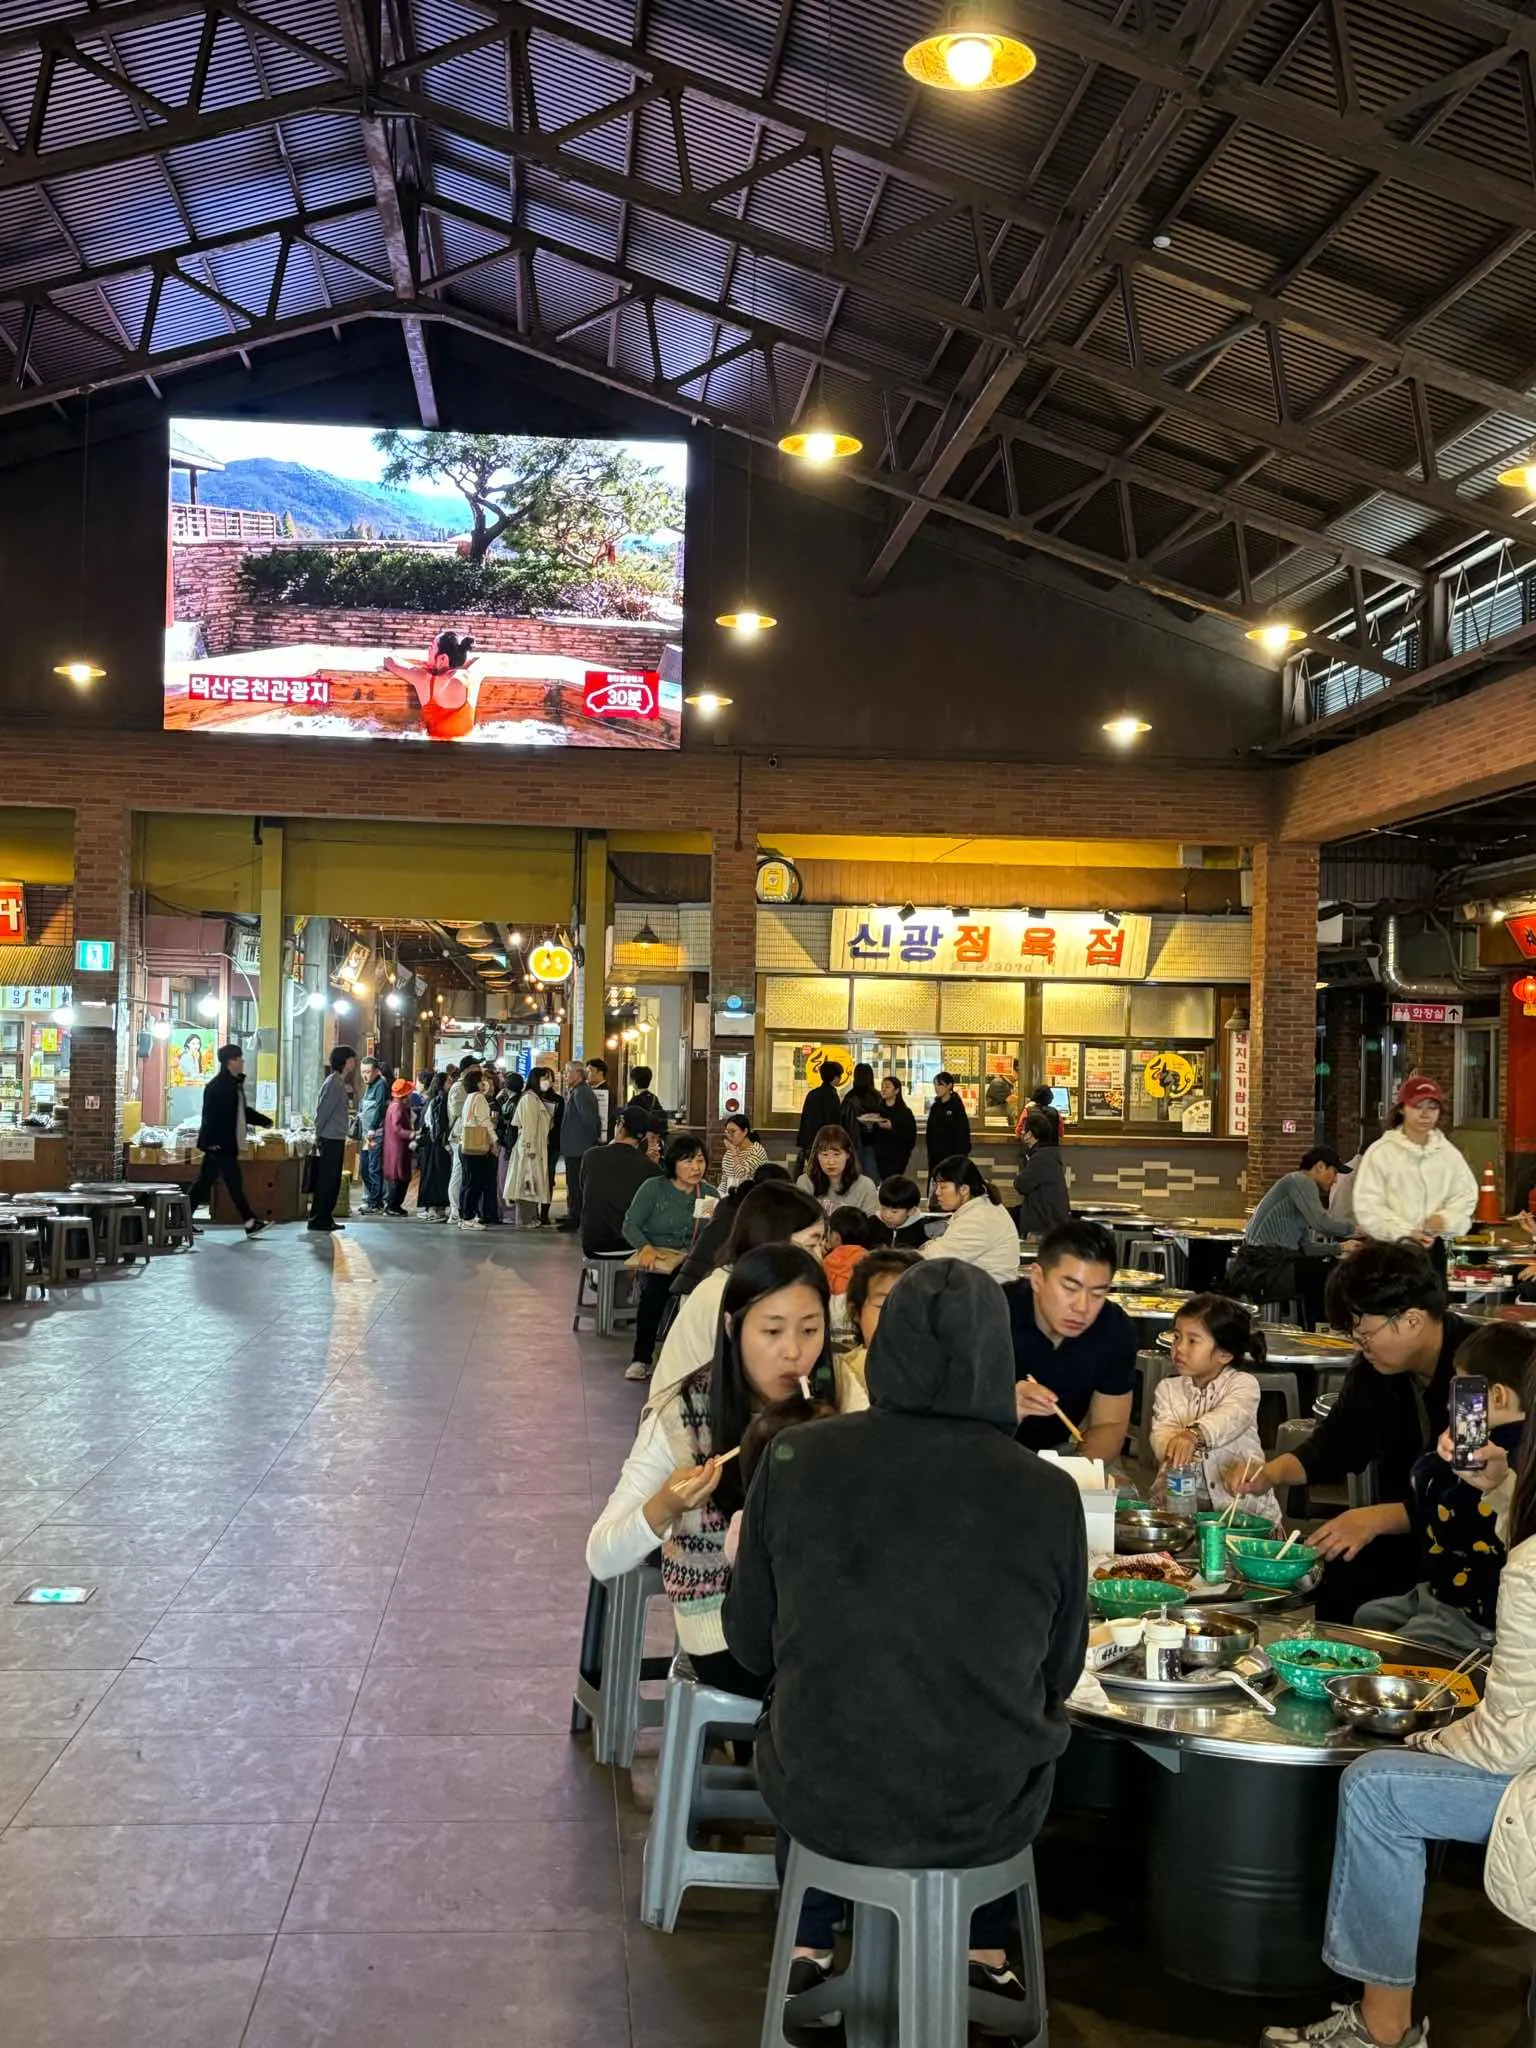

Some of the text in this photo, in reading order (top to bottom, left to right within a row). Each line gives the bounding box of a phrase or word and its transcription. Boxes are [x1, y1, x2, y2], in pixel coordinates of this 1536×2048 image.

[192, 677, 328, 703] 덕산온천관광지
[607, 688, 642, 707] 30분
[848, 923, 944, 962] 신광
[1411, 1007, 1444, 1020] 화장실
